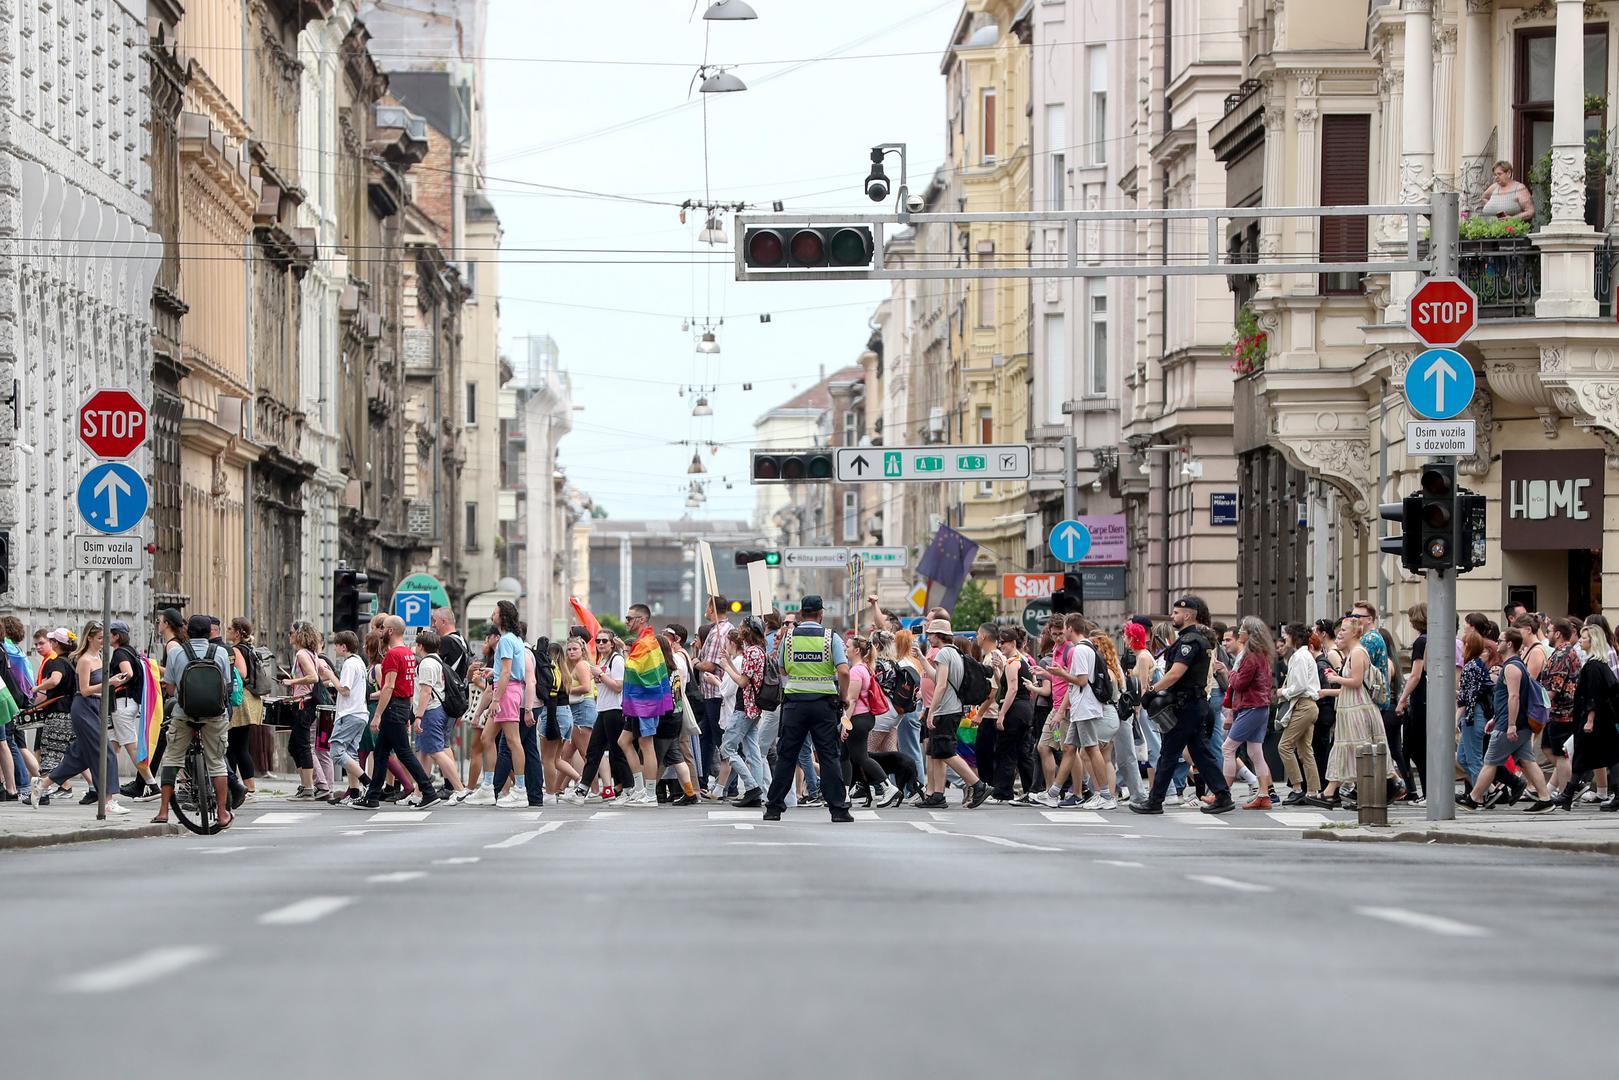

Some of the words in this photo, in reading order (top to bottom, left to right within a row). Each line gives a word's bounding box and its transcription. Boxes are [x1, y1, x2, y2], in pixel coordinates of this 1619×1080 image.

[1418, 301, 1468, 324] STOP
[83, 409, 143, 438] STOP
[1415, 426, 1437, 438] Osim
[1441, 426, 1466, 438] vozila
[1416, 441, 1421, 450] s
[1424, 439, 1466, 450] dozvolom
[1510, 478, 1590, 520] HOME
[1088, 525, 1108, 536] Carpe
[1108, 524, 1125, 534] Diem
[83, 541, 104, 553] Osim
[107, 541, 133, 553] vozila
[84, 555, 89, 564] s
[92, 553, 133, 565] dozvolom
[1014, 575, 1056, 597] Sax!
[406, 602, 420, 623] P
